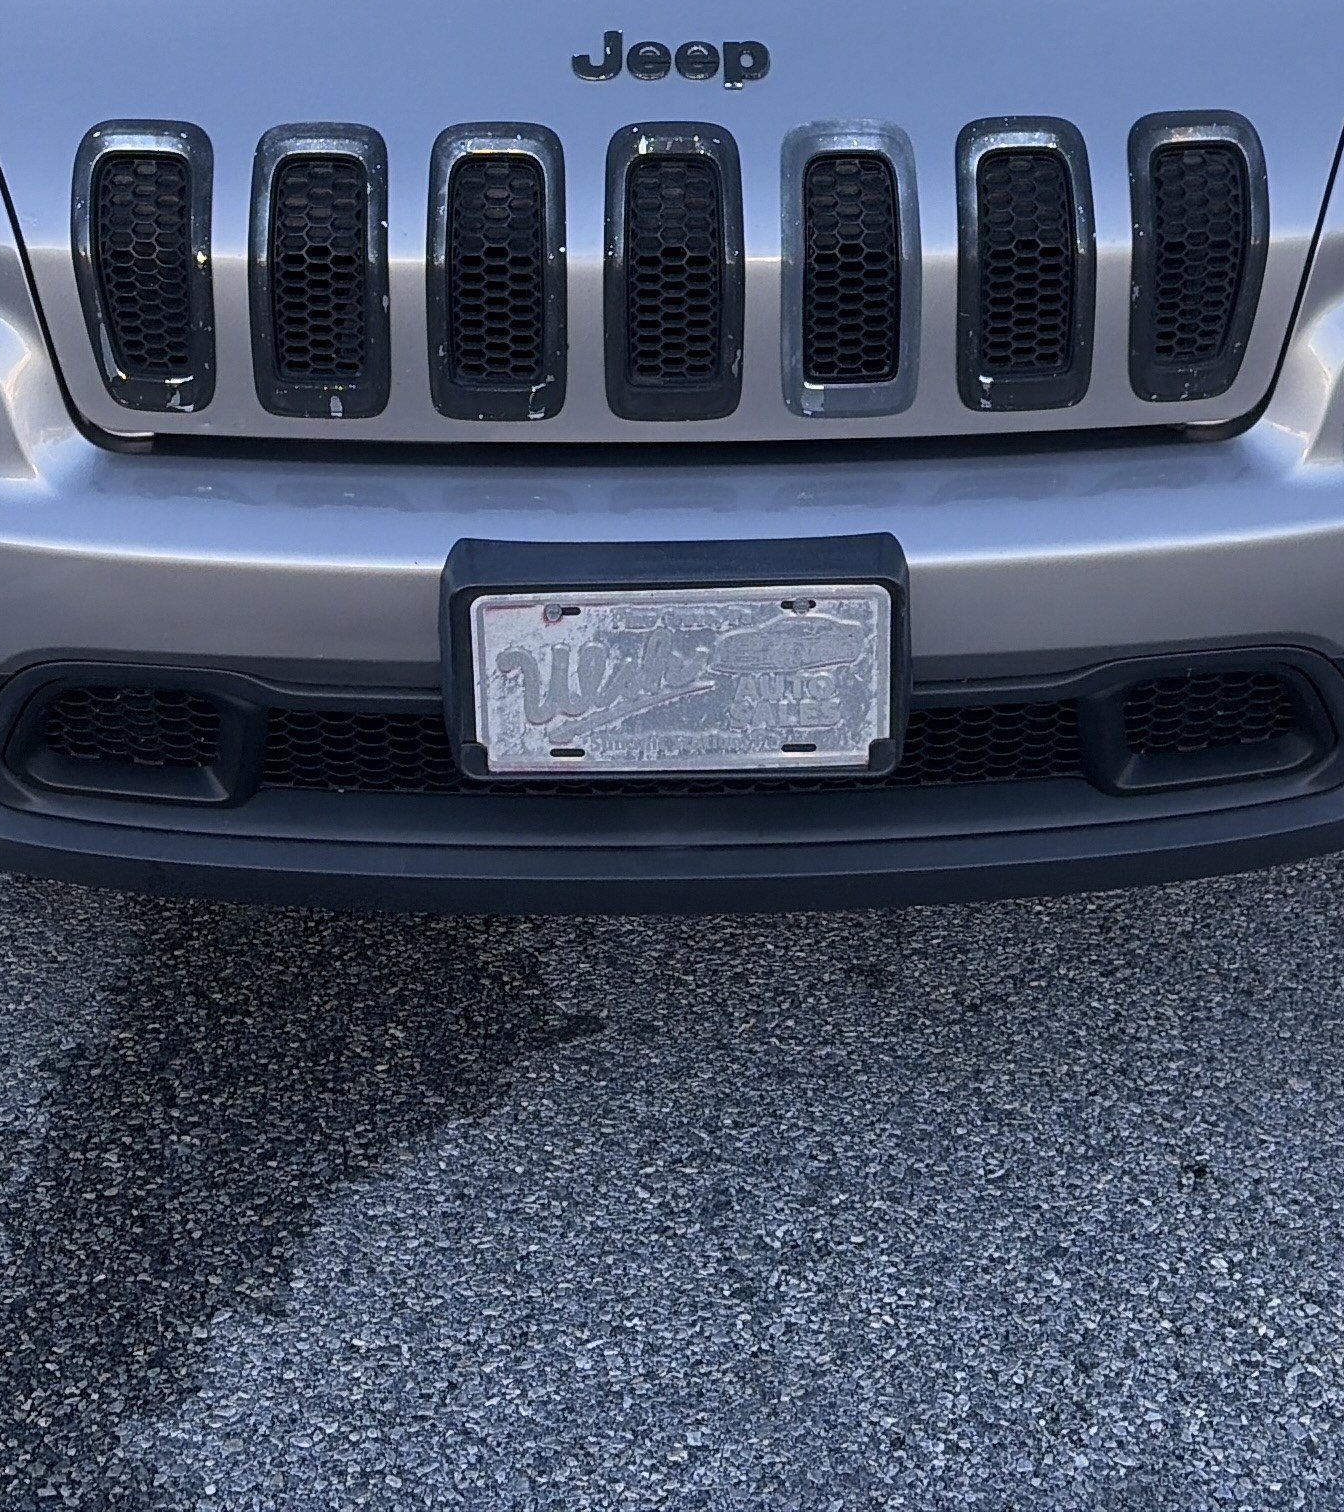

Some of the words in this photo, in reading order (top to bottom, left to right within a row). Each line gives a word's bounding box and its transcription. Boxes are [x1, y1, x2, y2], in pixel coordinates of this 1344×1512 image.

[572, 29, 771, 91] Jeep
[734, 672, 837, 701] AUTO
[729, 700, 841, 729] SALES
